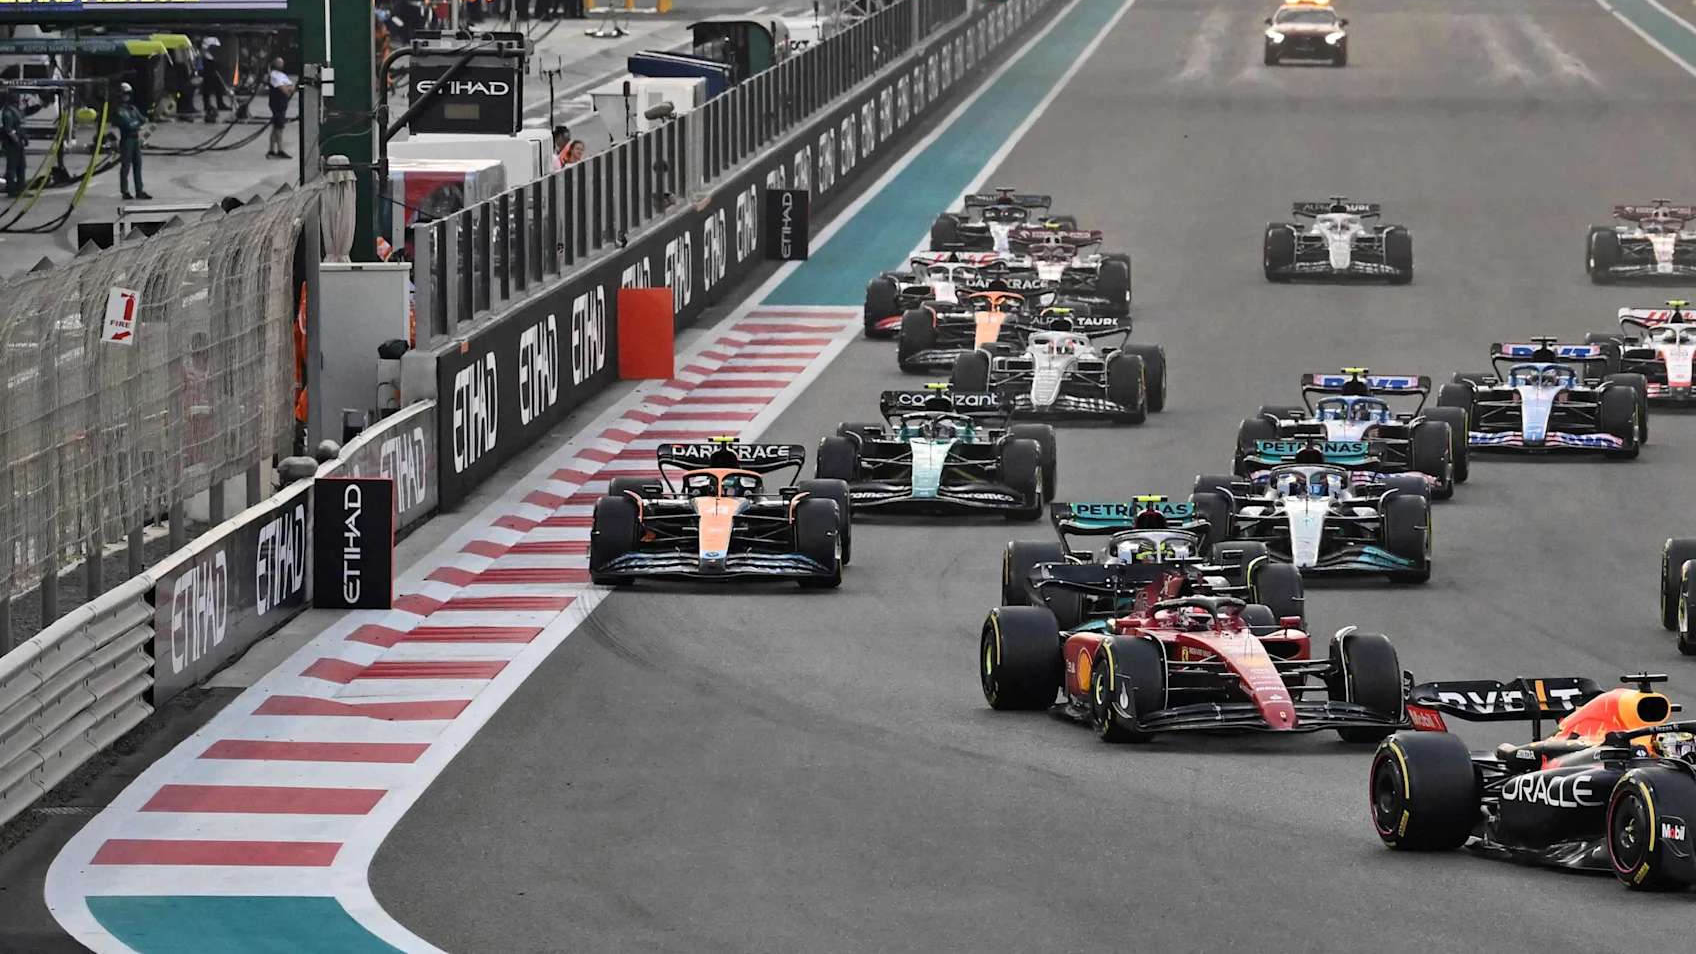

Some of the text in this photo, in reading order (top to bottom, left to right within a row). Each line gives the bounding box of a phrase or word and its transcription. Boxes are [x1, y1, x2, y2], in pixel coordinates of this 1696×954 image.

[703, 208, 726, 291] ETIHAD
[781, 191, 792, 259] ETIHAD
[664, 230, 692, 315] ETIHAD
[110, 319, 131, 329] FIRE
[572, 284, 605, 386] ETIHAD
[519, 313, 559, 426] ETIHAD
[899, 392, 998, 406] coizant
[453, 351, 498, 474] ETIHAD
[1263, 440, 1364, 453] PETNAS
[672, 445, 790, 458] DARRACE
[256, 504, 305, 615] ETIHAD
[343, 483, 362, 604] ETIHAD
[171, 550, 228, 674] ETIHAD
[1438, 680, 1583, 713] BYBIT
[1502, 774, 1605, 808] ORACLE
[1662, 822, 1686, 841] Mobil
